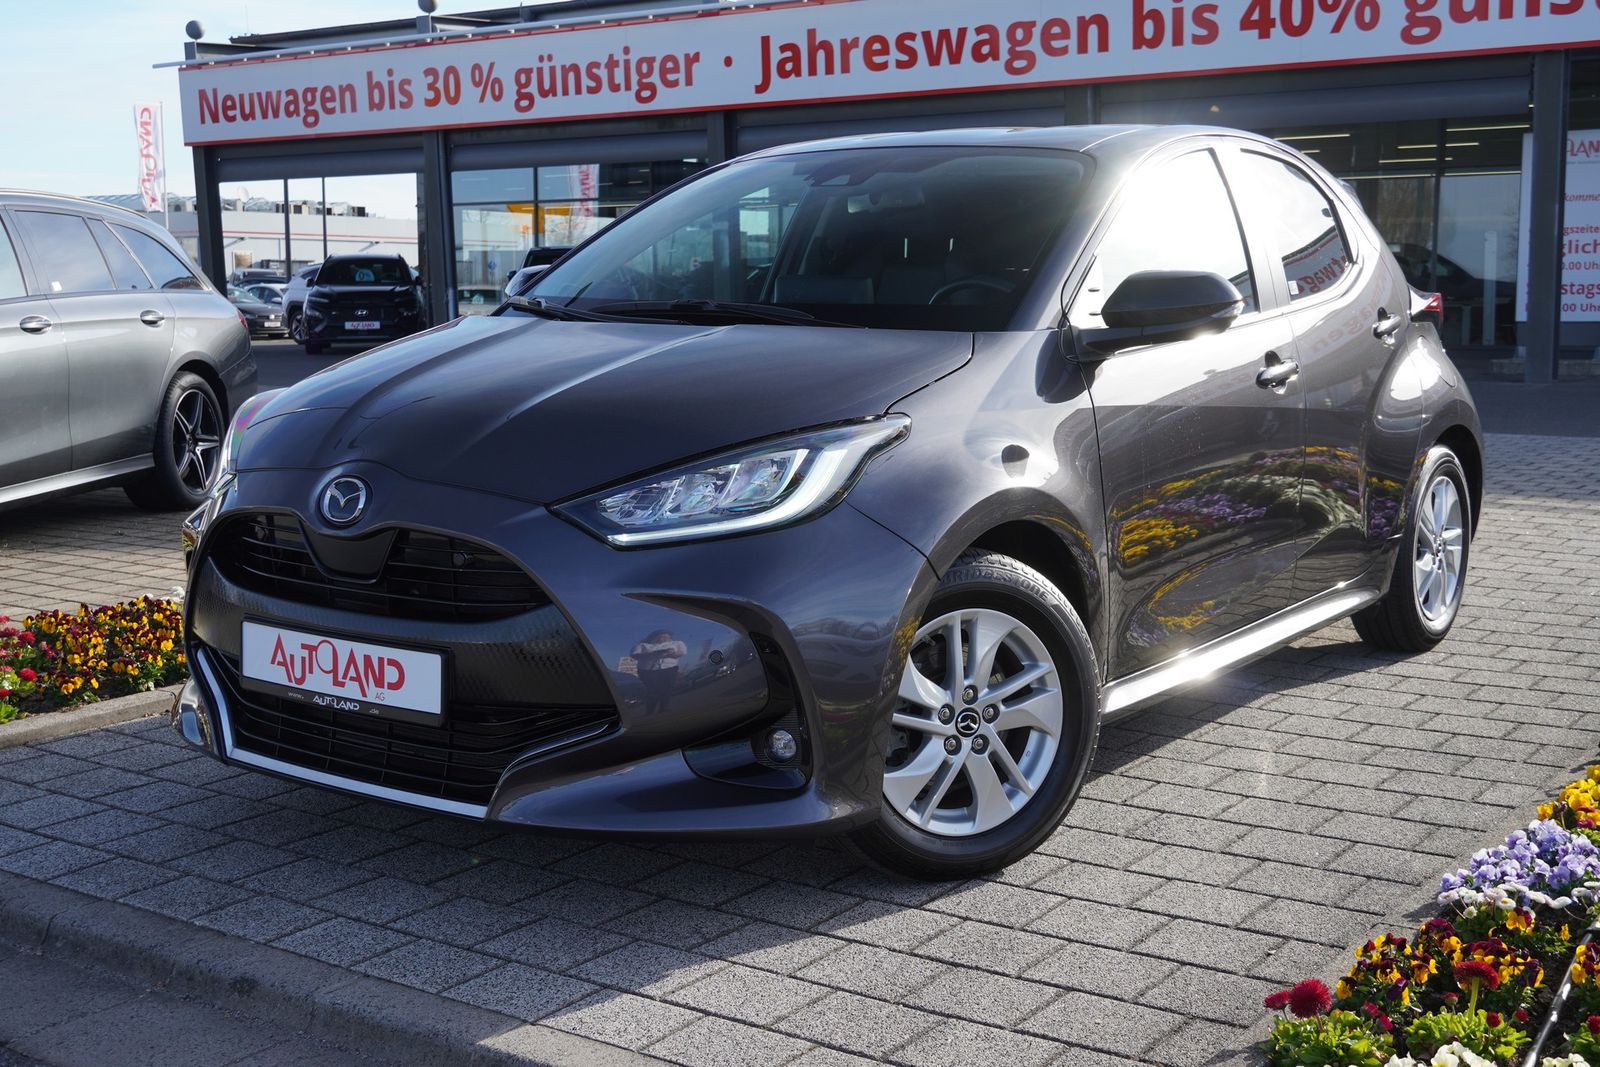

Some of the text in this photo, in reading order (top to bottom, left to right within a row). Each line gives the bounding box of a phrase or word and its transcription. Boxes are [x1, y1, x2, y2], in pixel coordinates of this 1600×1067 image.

[198, 86, 357, 129] Neuwagen
[367, 69, 413, 110] bis
[423, 65, 461, 107] 30
[471, 62, 503, 102] %
[514, 47, 701, 113] günstiger
[755, 14, 1109, 95] Jahreswagen
[1132, 0, 1220, 49] bis
[1239, 0, 1380, 40] 40%
[270, 633, 405, 698] AUTOLAND
[312, 694, 360, 711] AUTOLAND
